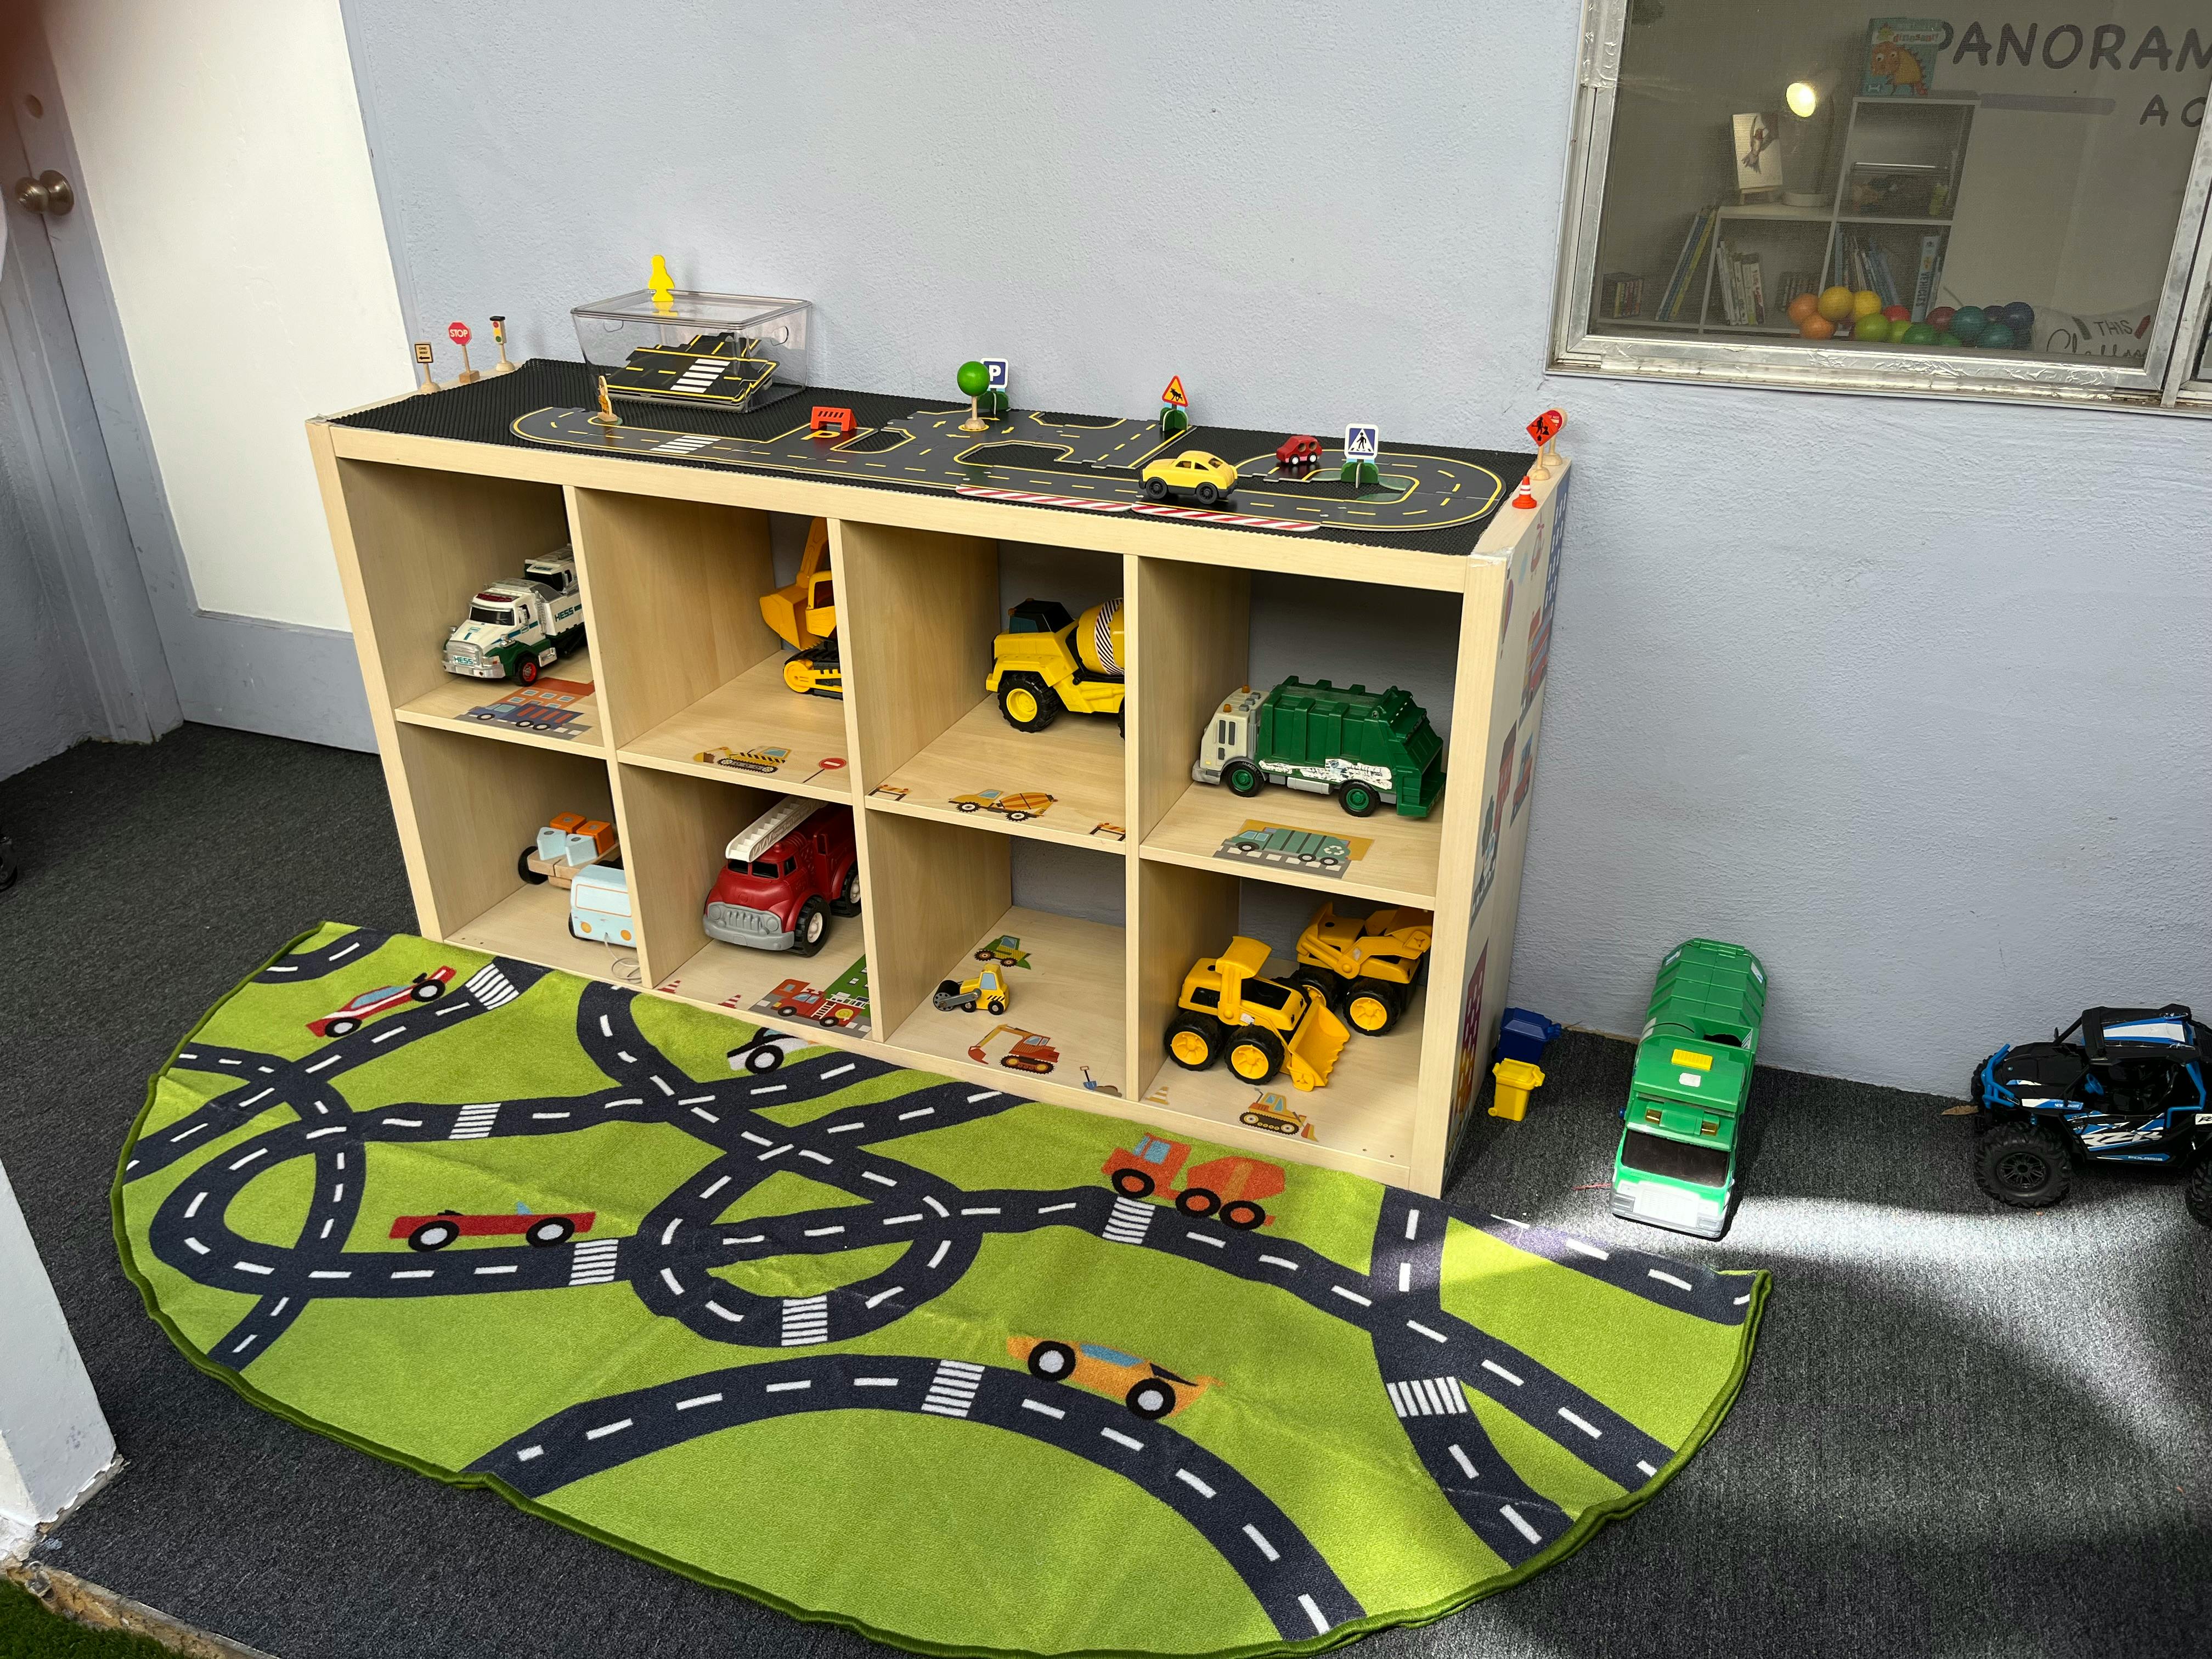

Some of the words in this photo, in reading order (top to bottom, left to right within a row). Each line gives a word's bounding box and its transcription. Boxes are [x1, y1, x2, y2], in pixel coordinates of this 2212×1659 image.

[1916, 271, 1931, 307] VEHICLES
[449, 329, 468, 338] STOP
[2094, 320, 2133, 336] THIS
[989, 365, 1001, 381] P
[800, 430, 840, 441] P
[555, 606, 574, 622] HESS
[454, 656, 473, 665] HESS
